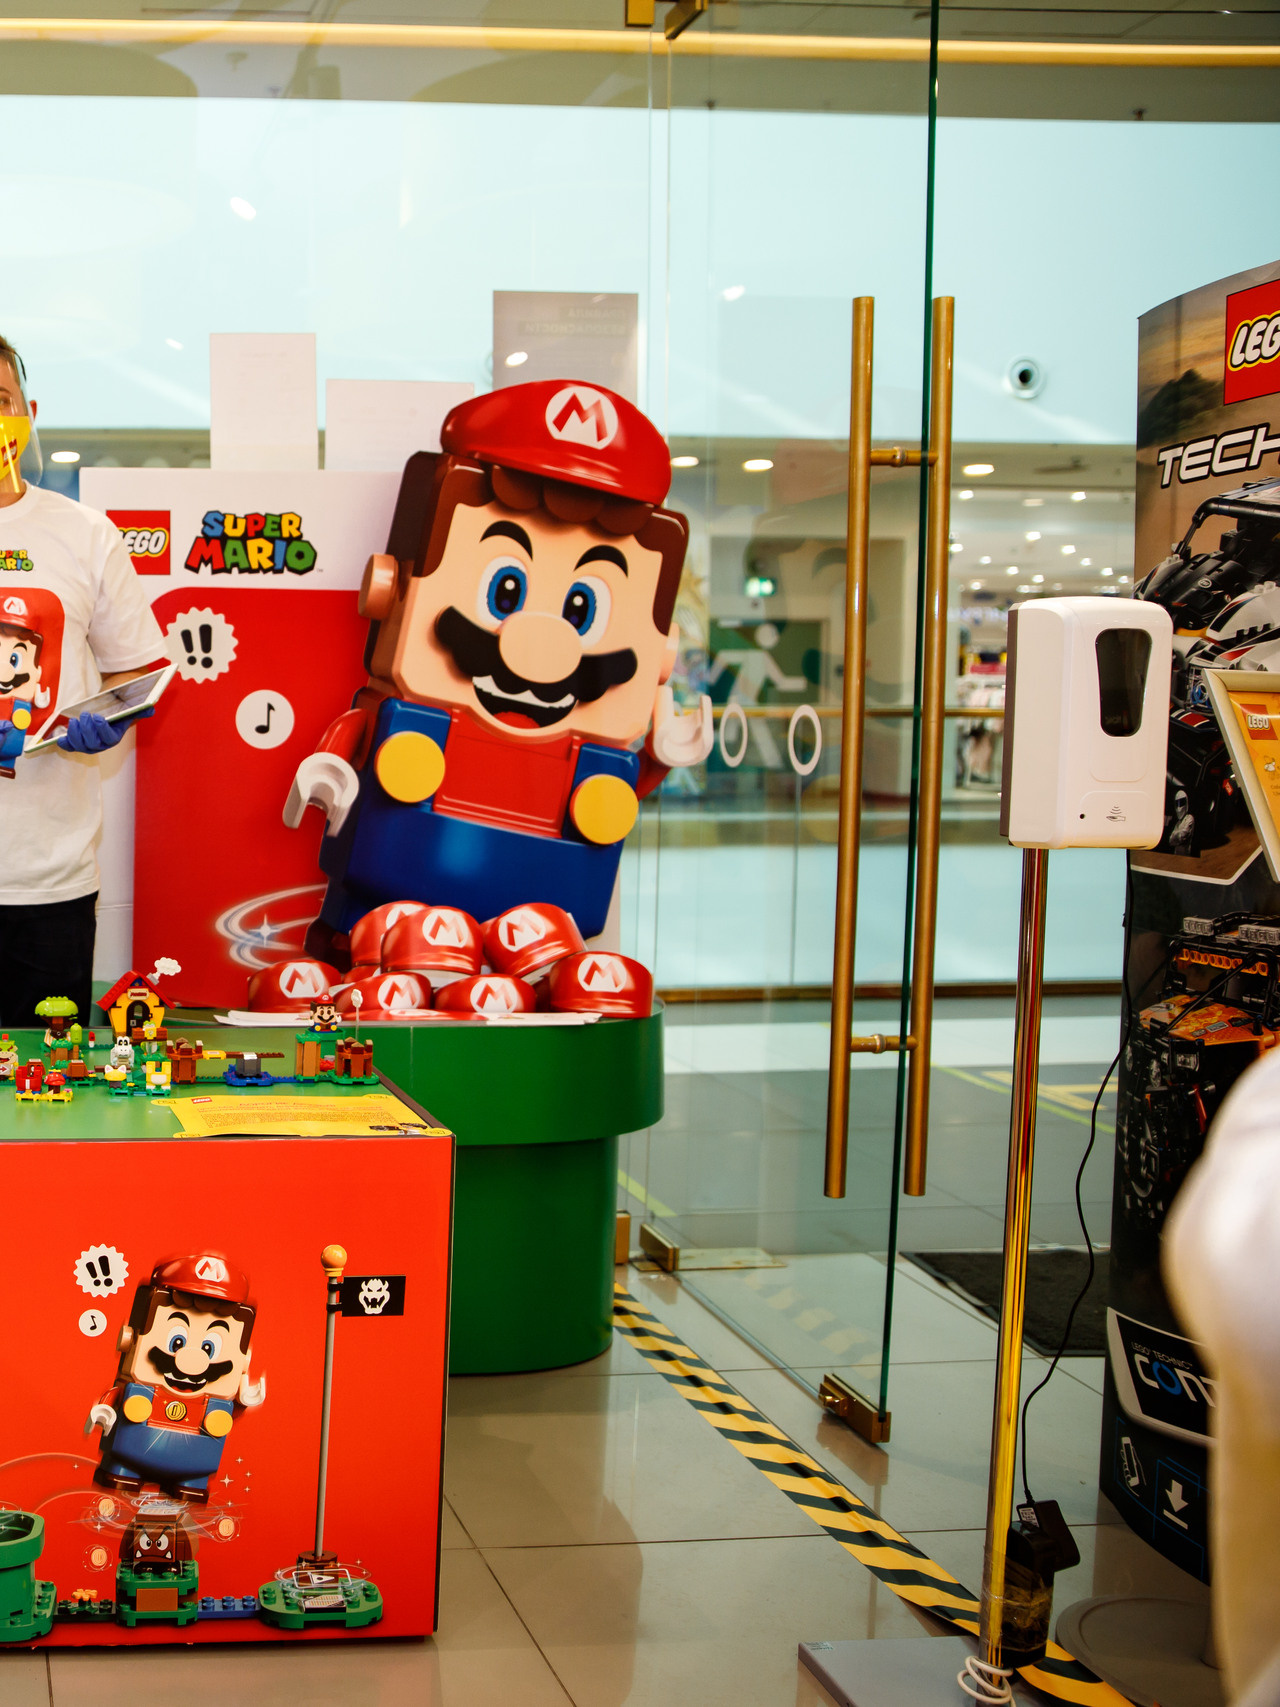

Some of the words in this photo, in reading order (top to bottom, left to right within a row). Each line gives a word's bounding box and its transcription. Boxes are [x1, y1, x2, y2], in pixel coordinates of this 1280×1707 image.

[1229, 312, 1280, 370] LEG
[1157, 423, 1280, 489] TECH
[202, 511, 303, 539] SUPER
[119, 528, 169, 557] EGO
[184, 536, 317, 575] MARIO
[1247, 714, 1270, 730] LEGO
